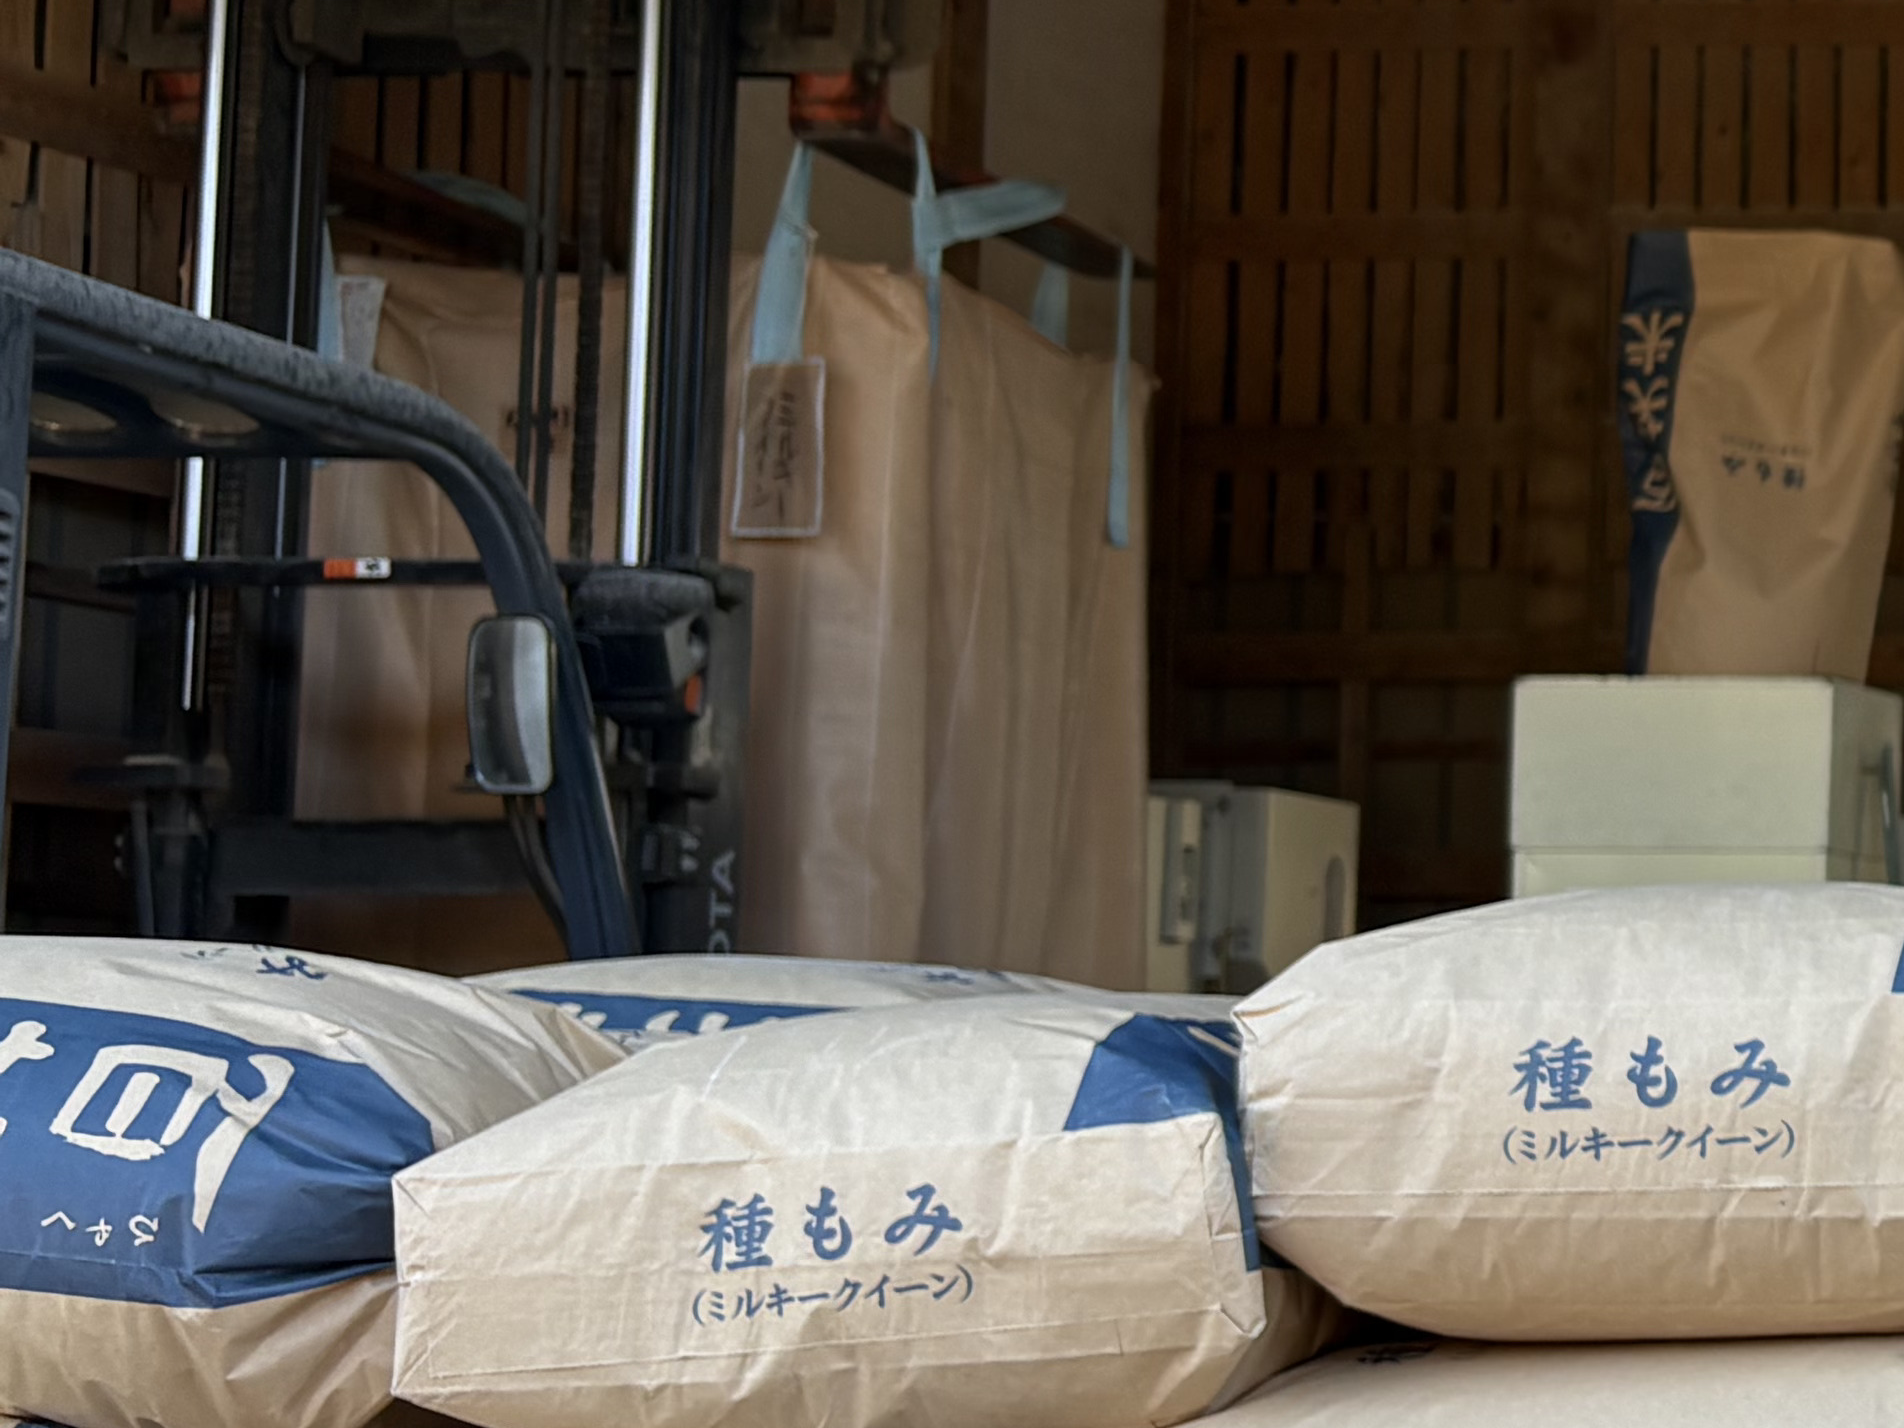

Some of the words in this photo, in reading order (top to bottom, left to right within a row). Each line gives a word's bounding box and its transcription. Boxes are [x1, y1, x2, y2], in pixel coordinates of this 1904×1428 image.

[1512, 1036, 1790, 1112] 種もみ
[699, 1184, 962, 1273] 種もみ
